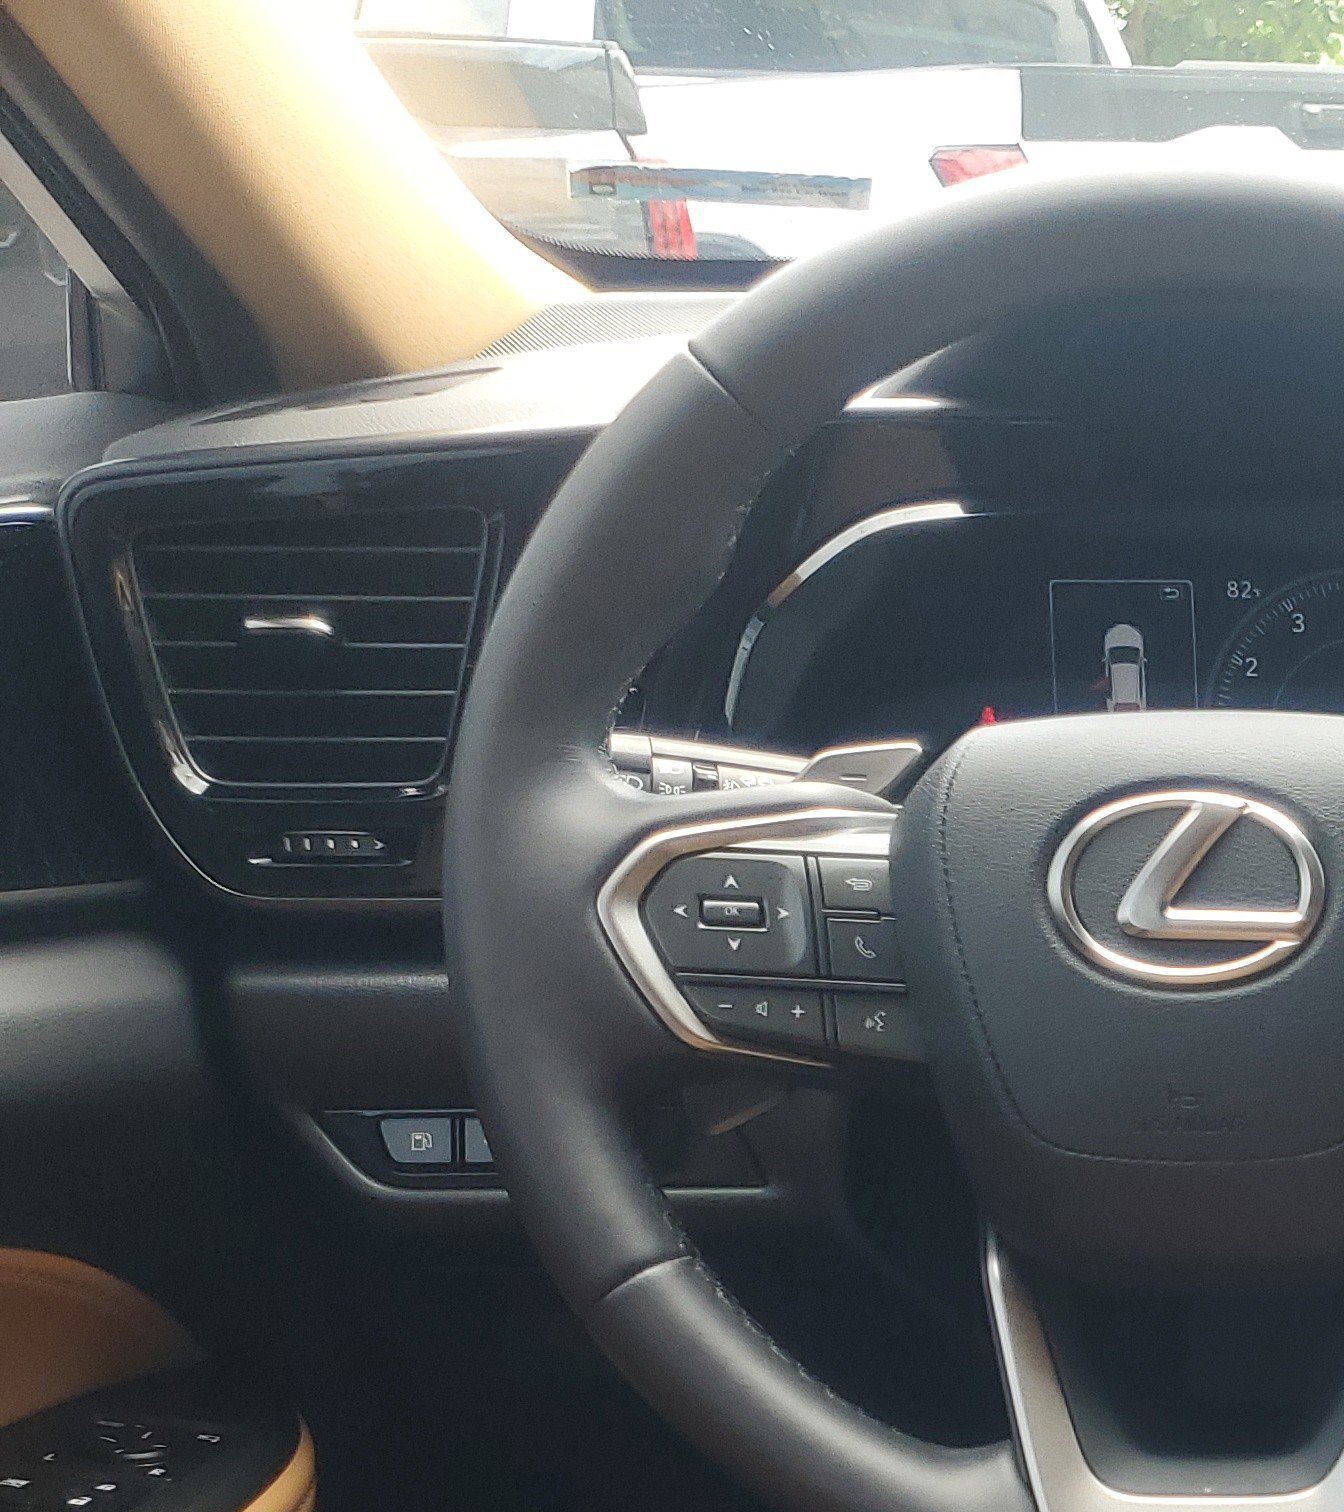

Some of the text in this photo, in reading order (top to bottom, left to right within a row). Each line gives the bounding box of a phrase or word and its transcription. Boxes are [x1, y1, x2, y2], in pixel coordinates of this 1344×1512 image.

[1292, 613, 1305, 634] 3
[1245, 657, 1259, 677] 2
[724, 906, 741, 917] OK
